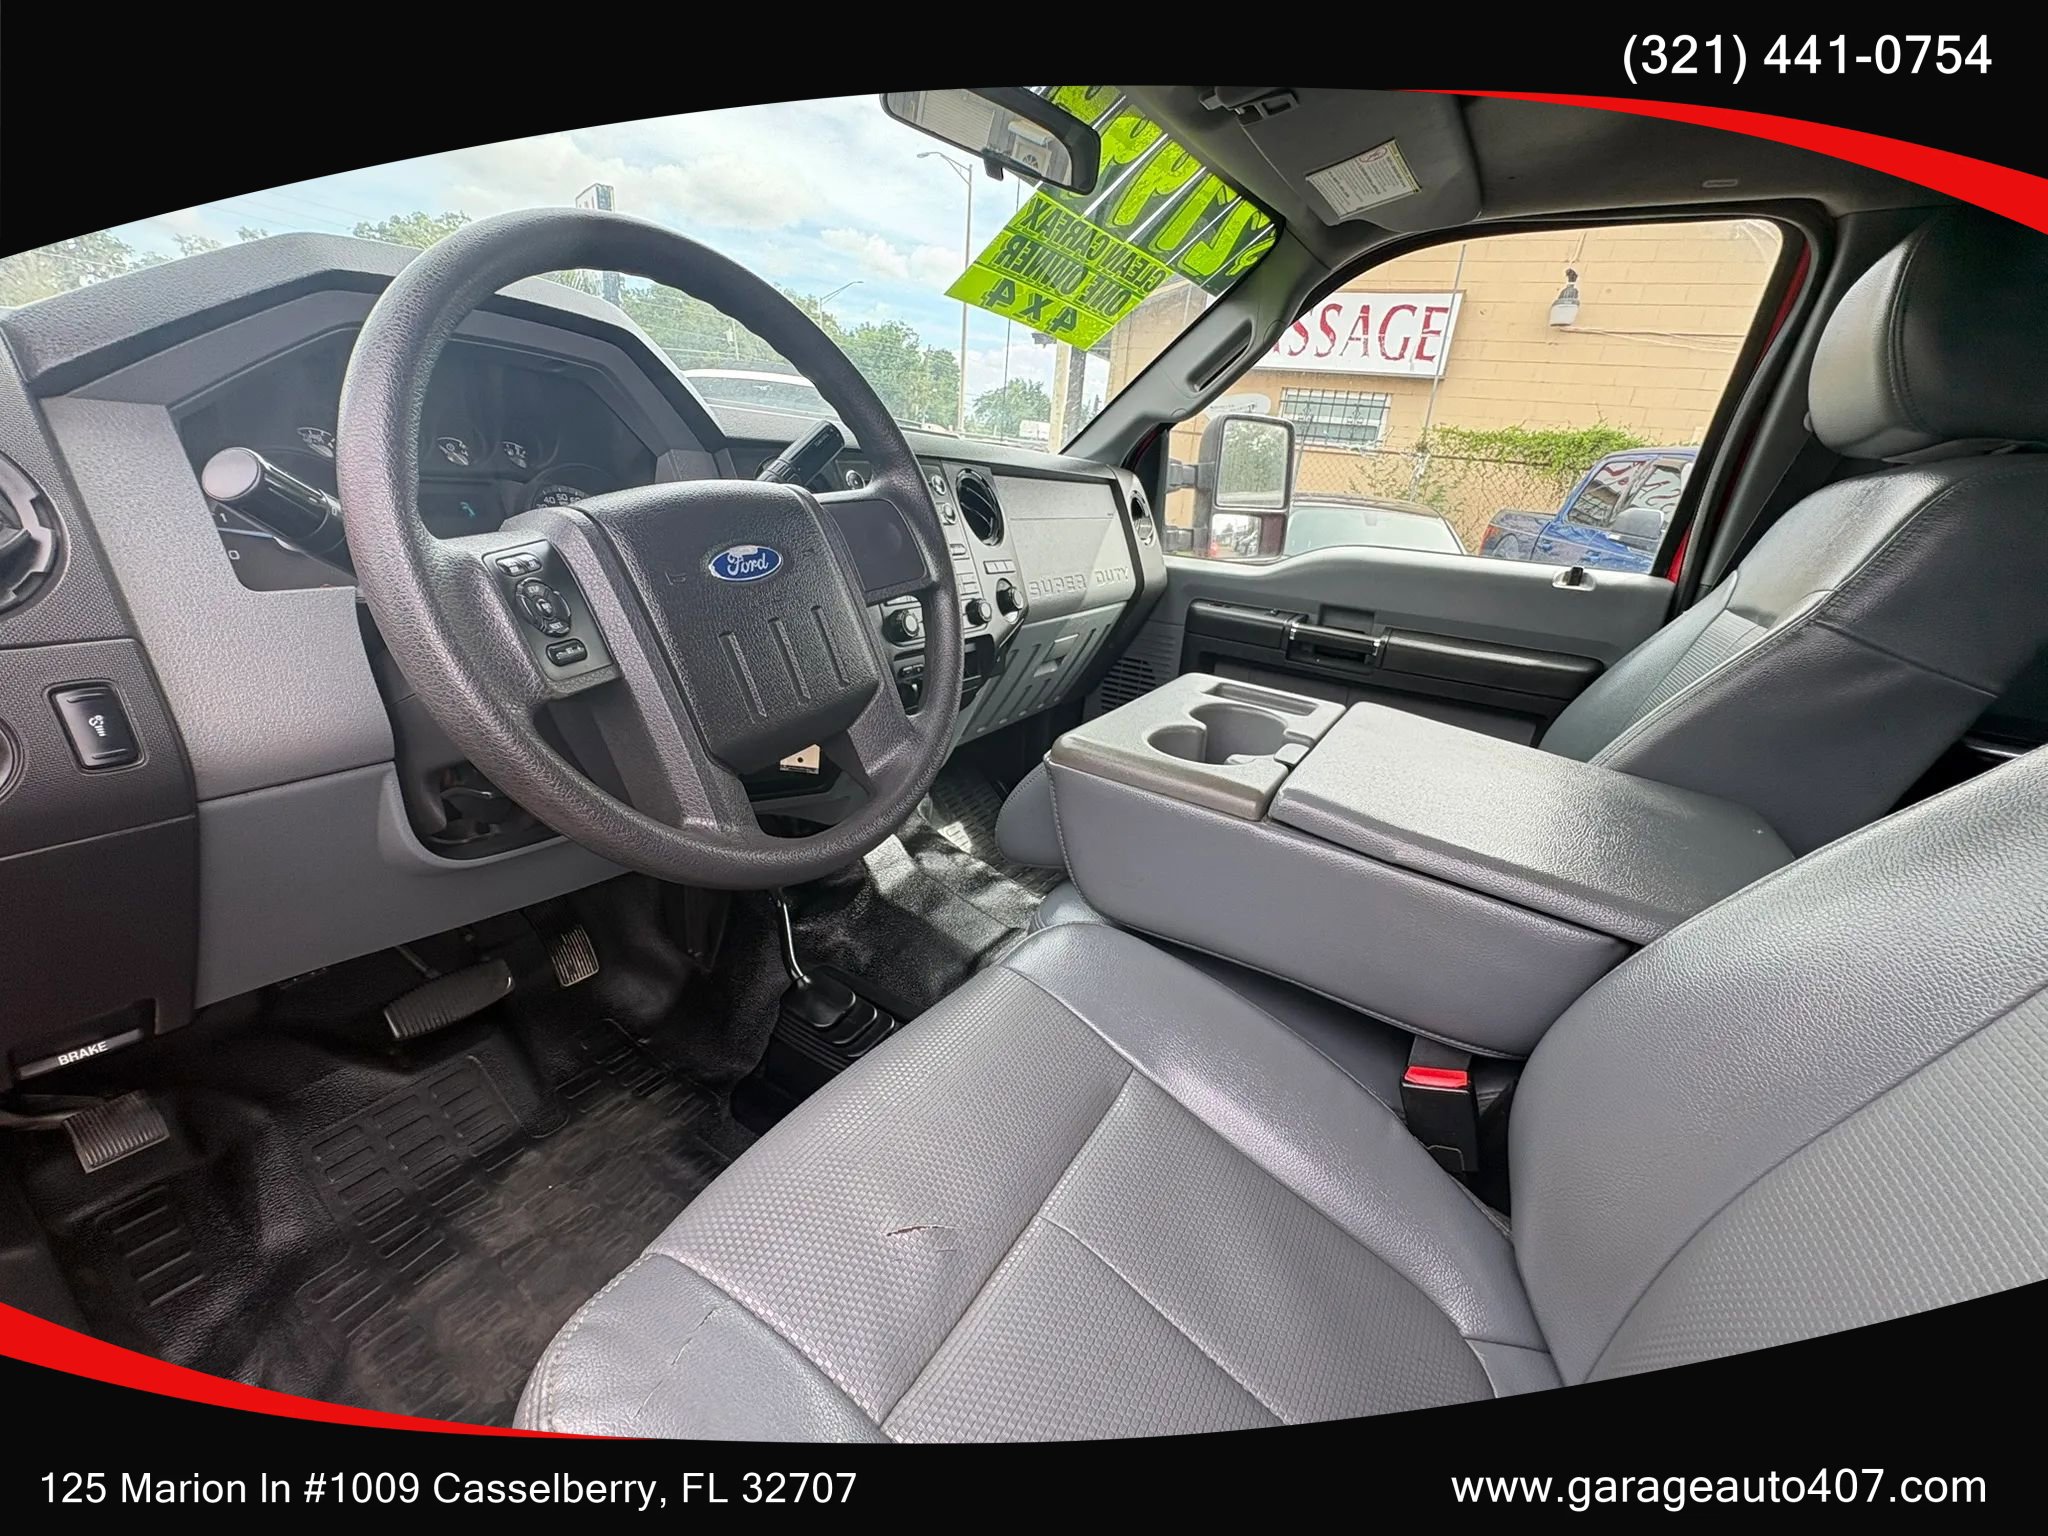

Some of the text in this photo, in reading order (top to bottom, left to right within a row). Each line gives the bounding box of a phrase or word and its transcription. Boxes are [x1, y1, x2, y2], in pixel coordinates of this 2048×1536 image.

[1272, 303, 1450, 362] SSAGE
[727, 552, 769, 576] Ford
[1029, 566, 1129, 598] SUPER DUTY
[57, 1041, 109, 1066] BRAKE
